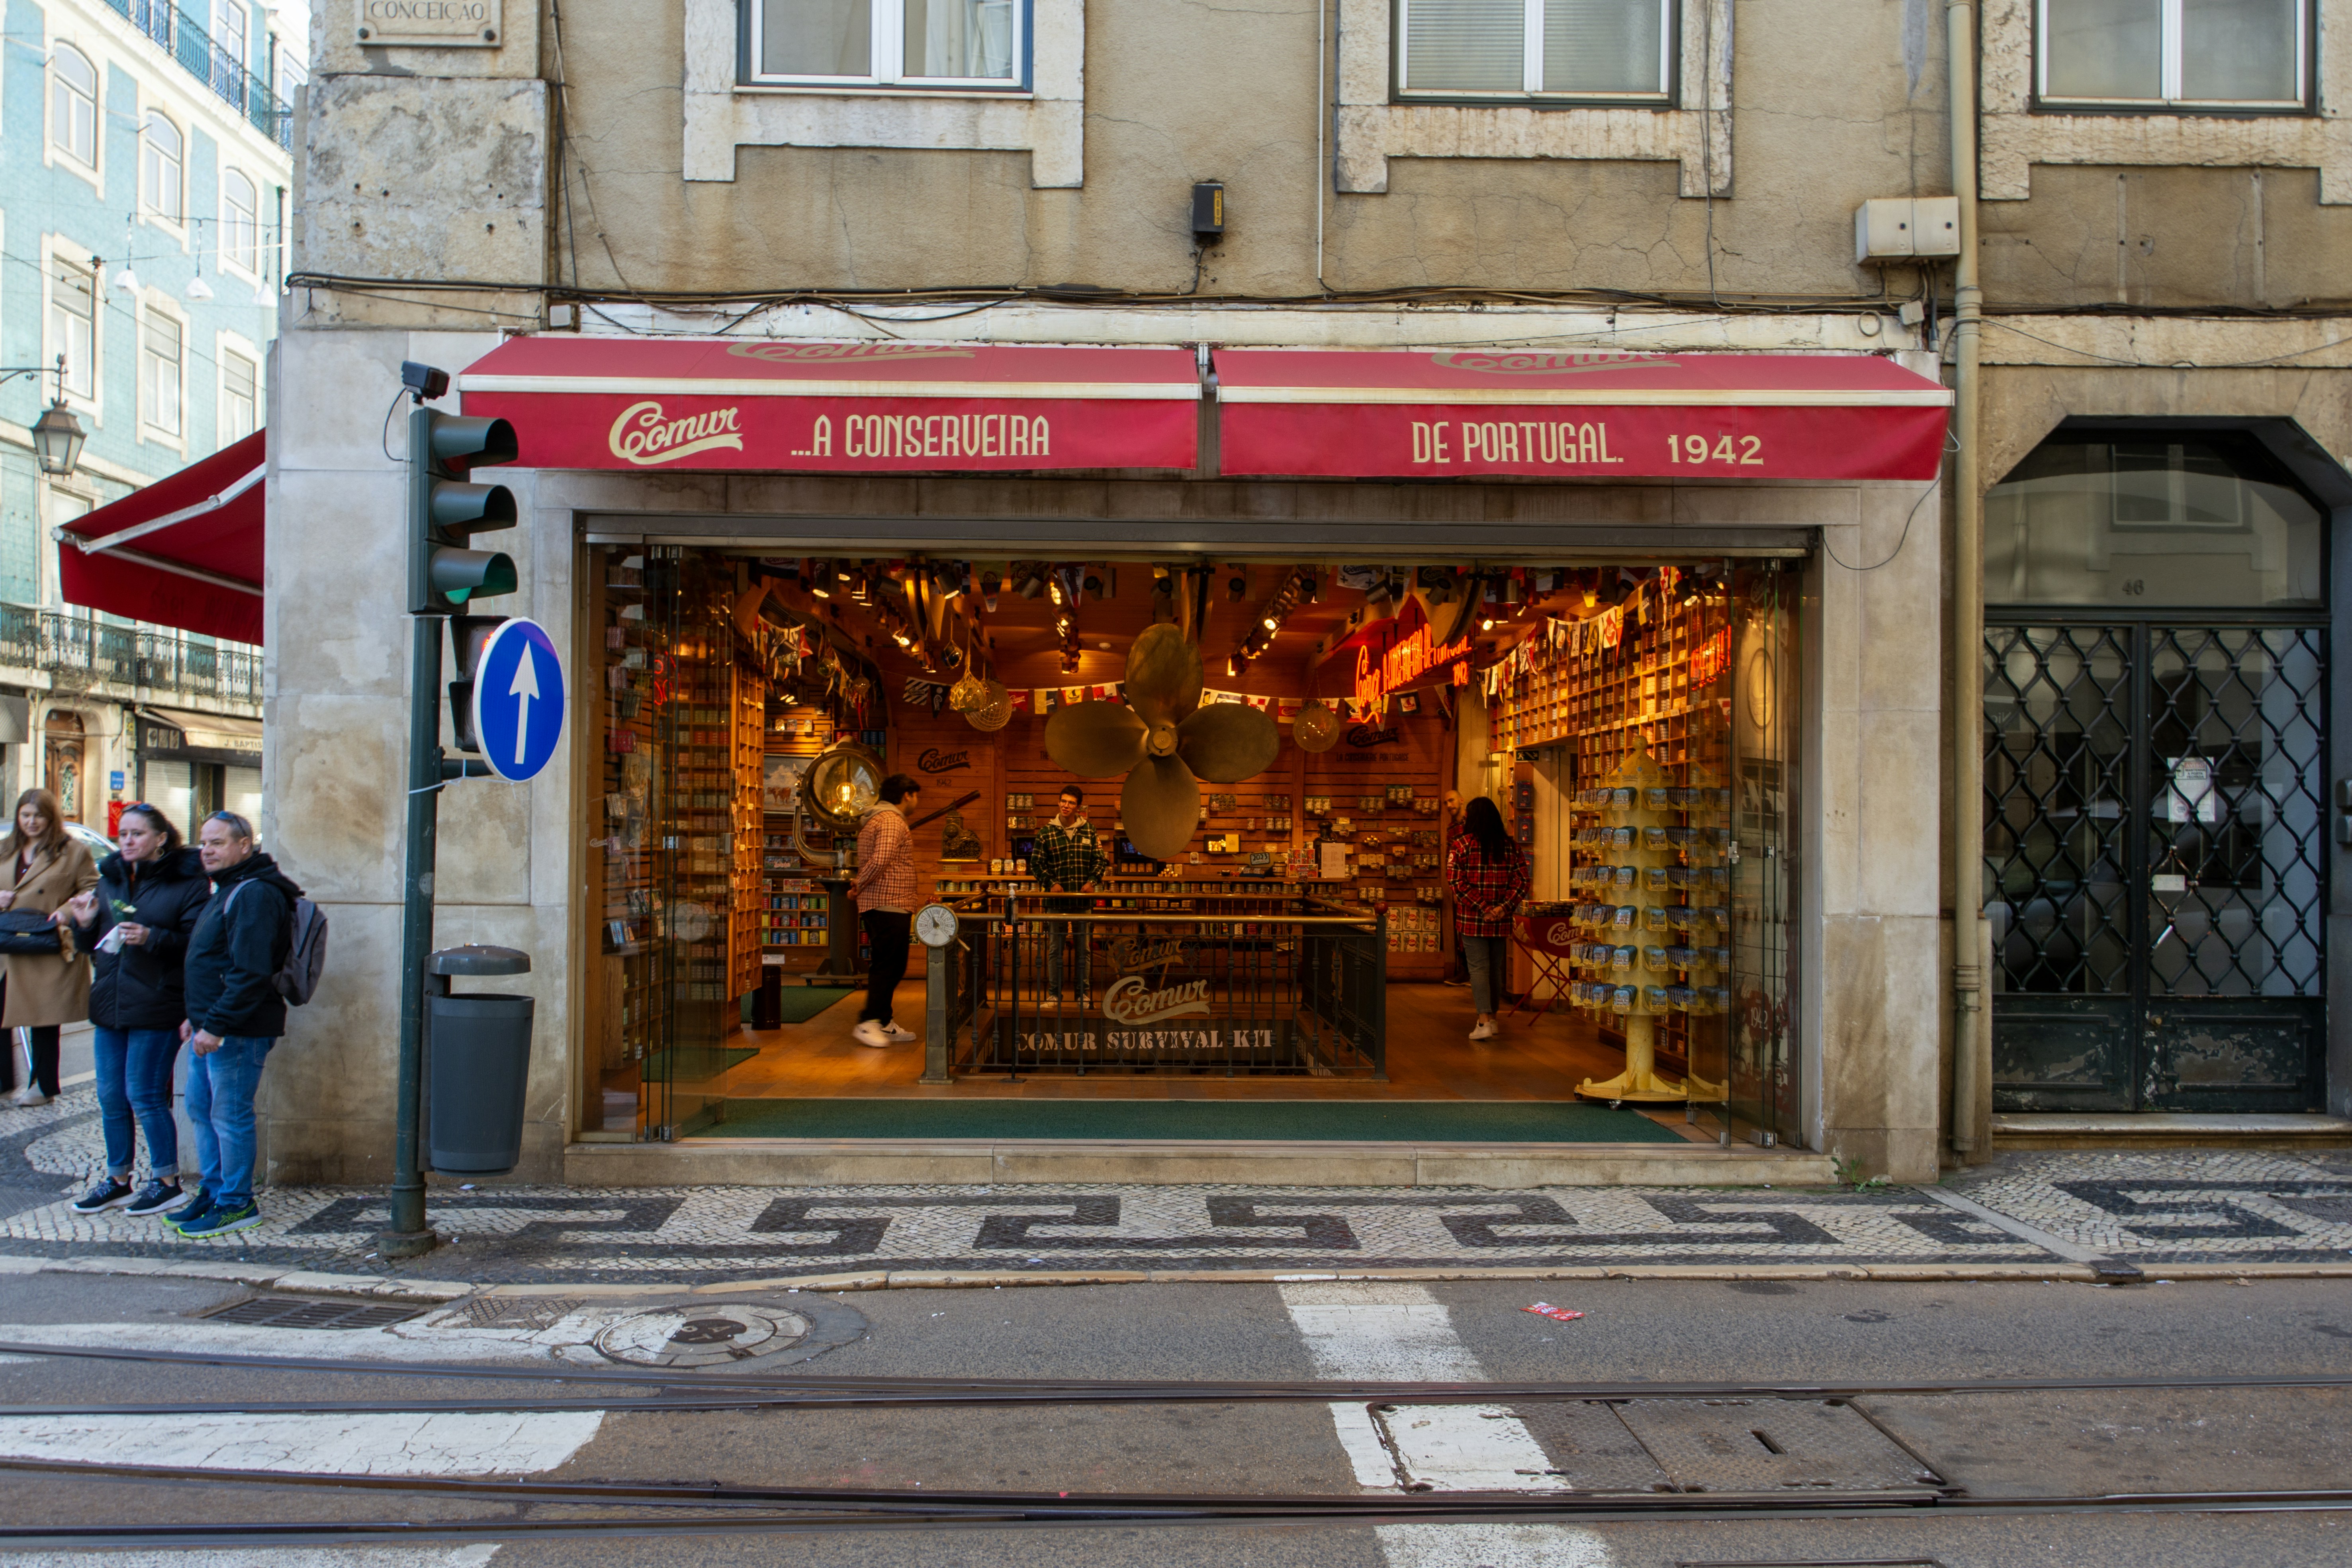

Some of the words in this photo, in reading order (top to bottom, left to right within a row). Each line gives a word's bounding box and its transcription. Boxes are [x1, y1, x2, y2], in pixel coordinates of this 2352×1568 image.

[609, 401, 744, 465] Comur
[845, 414, 1050, 458] CONSERVEIRA
[1411, 421, 1450, 464] DE
[1462, 421, 1624, 464] PORTUGAL.
[1667, 435, 1764, 465] 1942
[2123, 579, 2144, 595] 46
[1346, 725, 1399, 748] Comur
[918, 748, 971, 773] Comur
[1380, 753, 1409, 761] PORTUGAISE
[1102, 975, 1211, 1025] Comur
[1107, 1031, 1223, 1050] SURVIVAL
[1233, 1030, 1272, 1048] KIT
